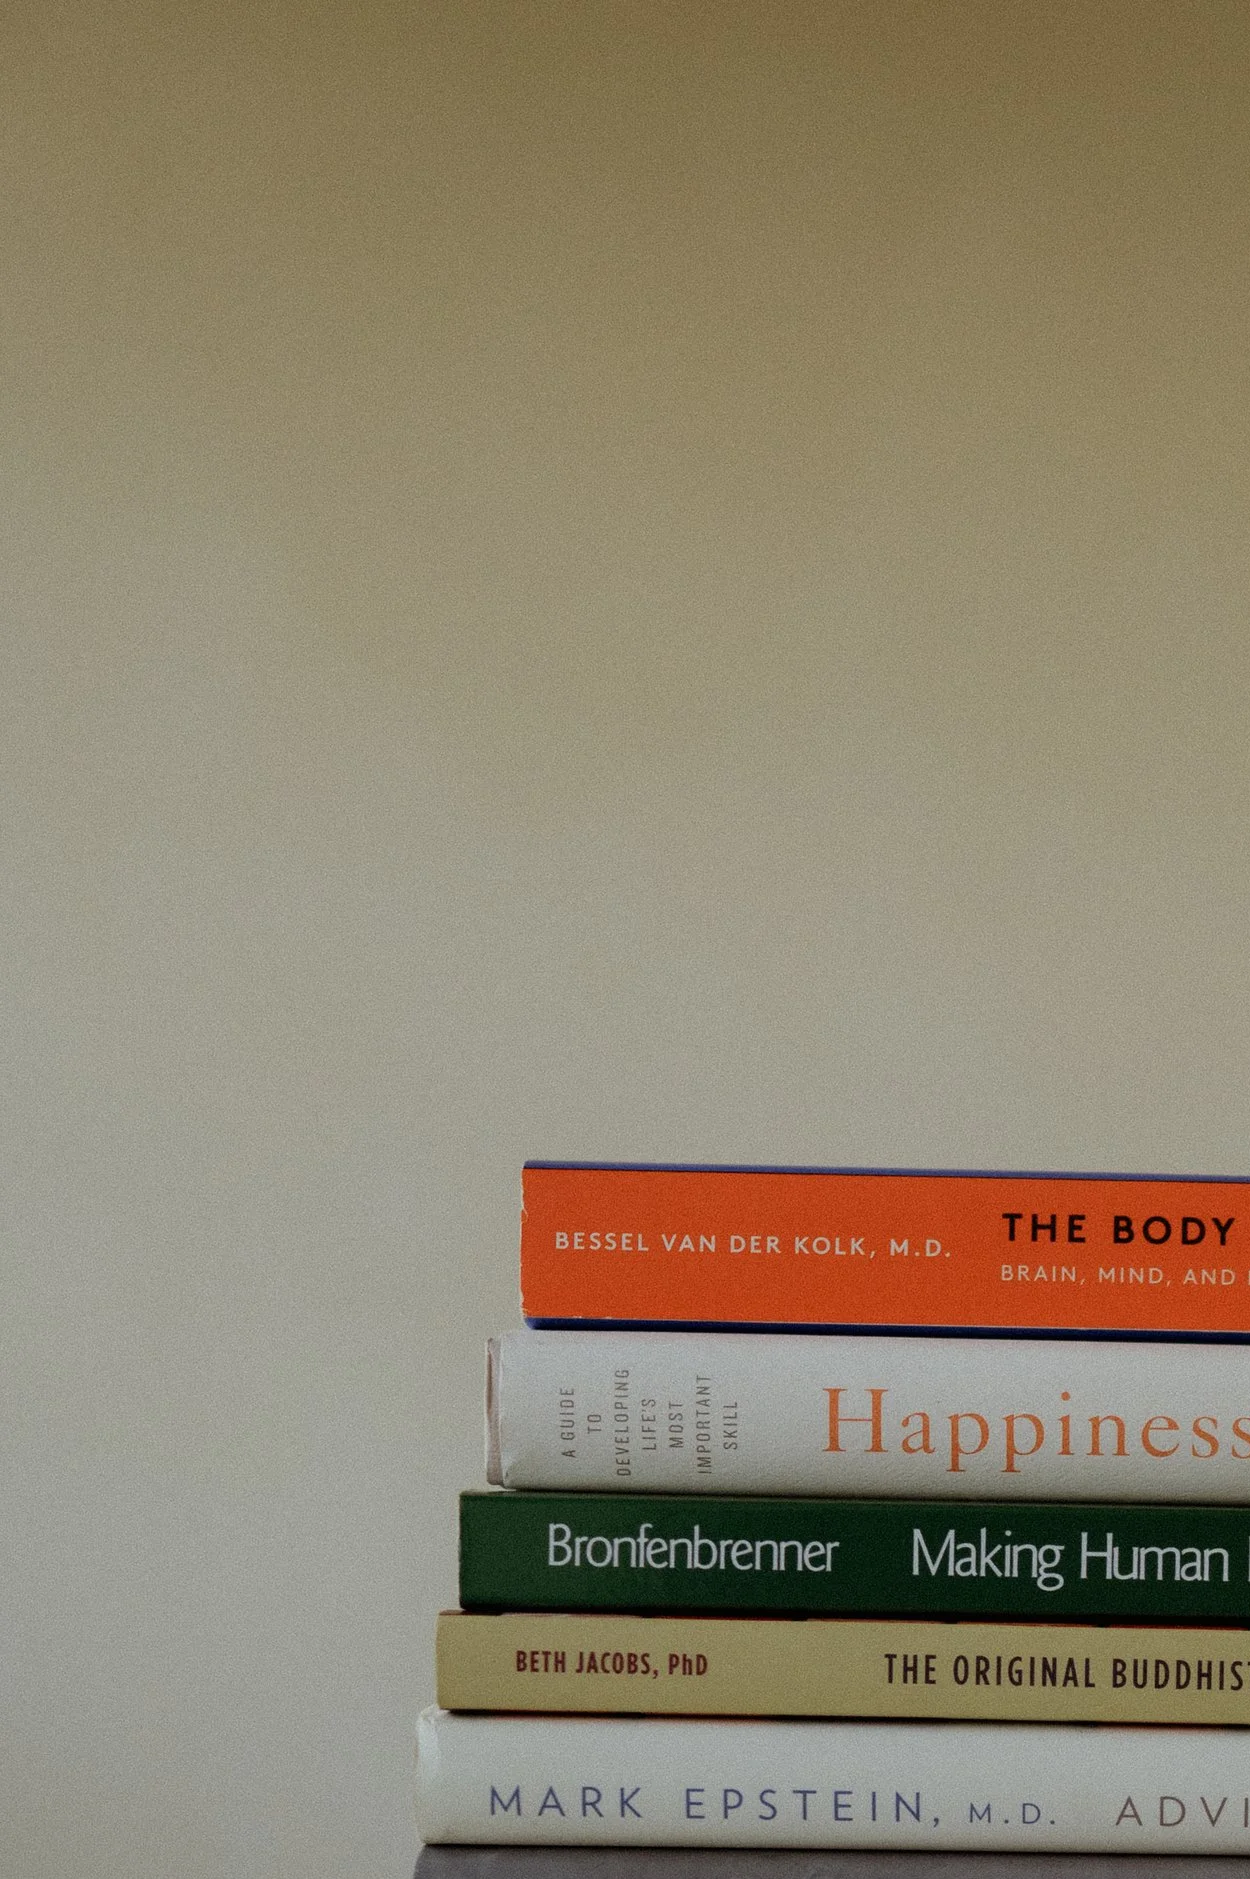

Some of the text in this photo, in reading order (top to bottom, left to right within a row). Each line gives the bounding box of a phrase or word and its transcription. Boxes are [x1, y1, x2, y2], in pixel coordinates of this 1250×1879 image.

[556, 1232, 951, 1258] BESSEL VAN DER KOLK, M.D.
[1001, 1213, 1087, 1243] THE
[1113, 1216, 1235, 1246] BODY
[1001, 1265, 1085, 1285] BRAIN,
[1099, 1266, 1170, 1285] MIND,
[1183, 1268, 1234, 1285] AND
[561, 1387, 575, 1458] A GUIDE
[587, 1413, 602, 1434] TO
[615, 1368, 630, 1476] DEVELOPING
[643, 1398, 657, 1451] LIFE'S
[669, 1400, 683, 1447] MOST
[697, 1375, 711, 1474] IMPORTANT
[724, 1401, 738, 1450] SKILL
[548, 1524, 840, 1572] Bronfenbrenner
[911, 1529, 1064, 1591] Making
[1081, 1532, 1229, 1582] Human
[516, 1650, 708, 1679] BETH JACOBS, PhD
[886, 1654, 938, 1685] THE
[952, 1656, 1096, 1689] ORIGINAL
[490, 1786, 1056, 1828] MARK EPSTEIN, M.D.
